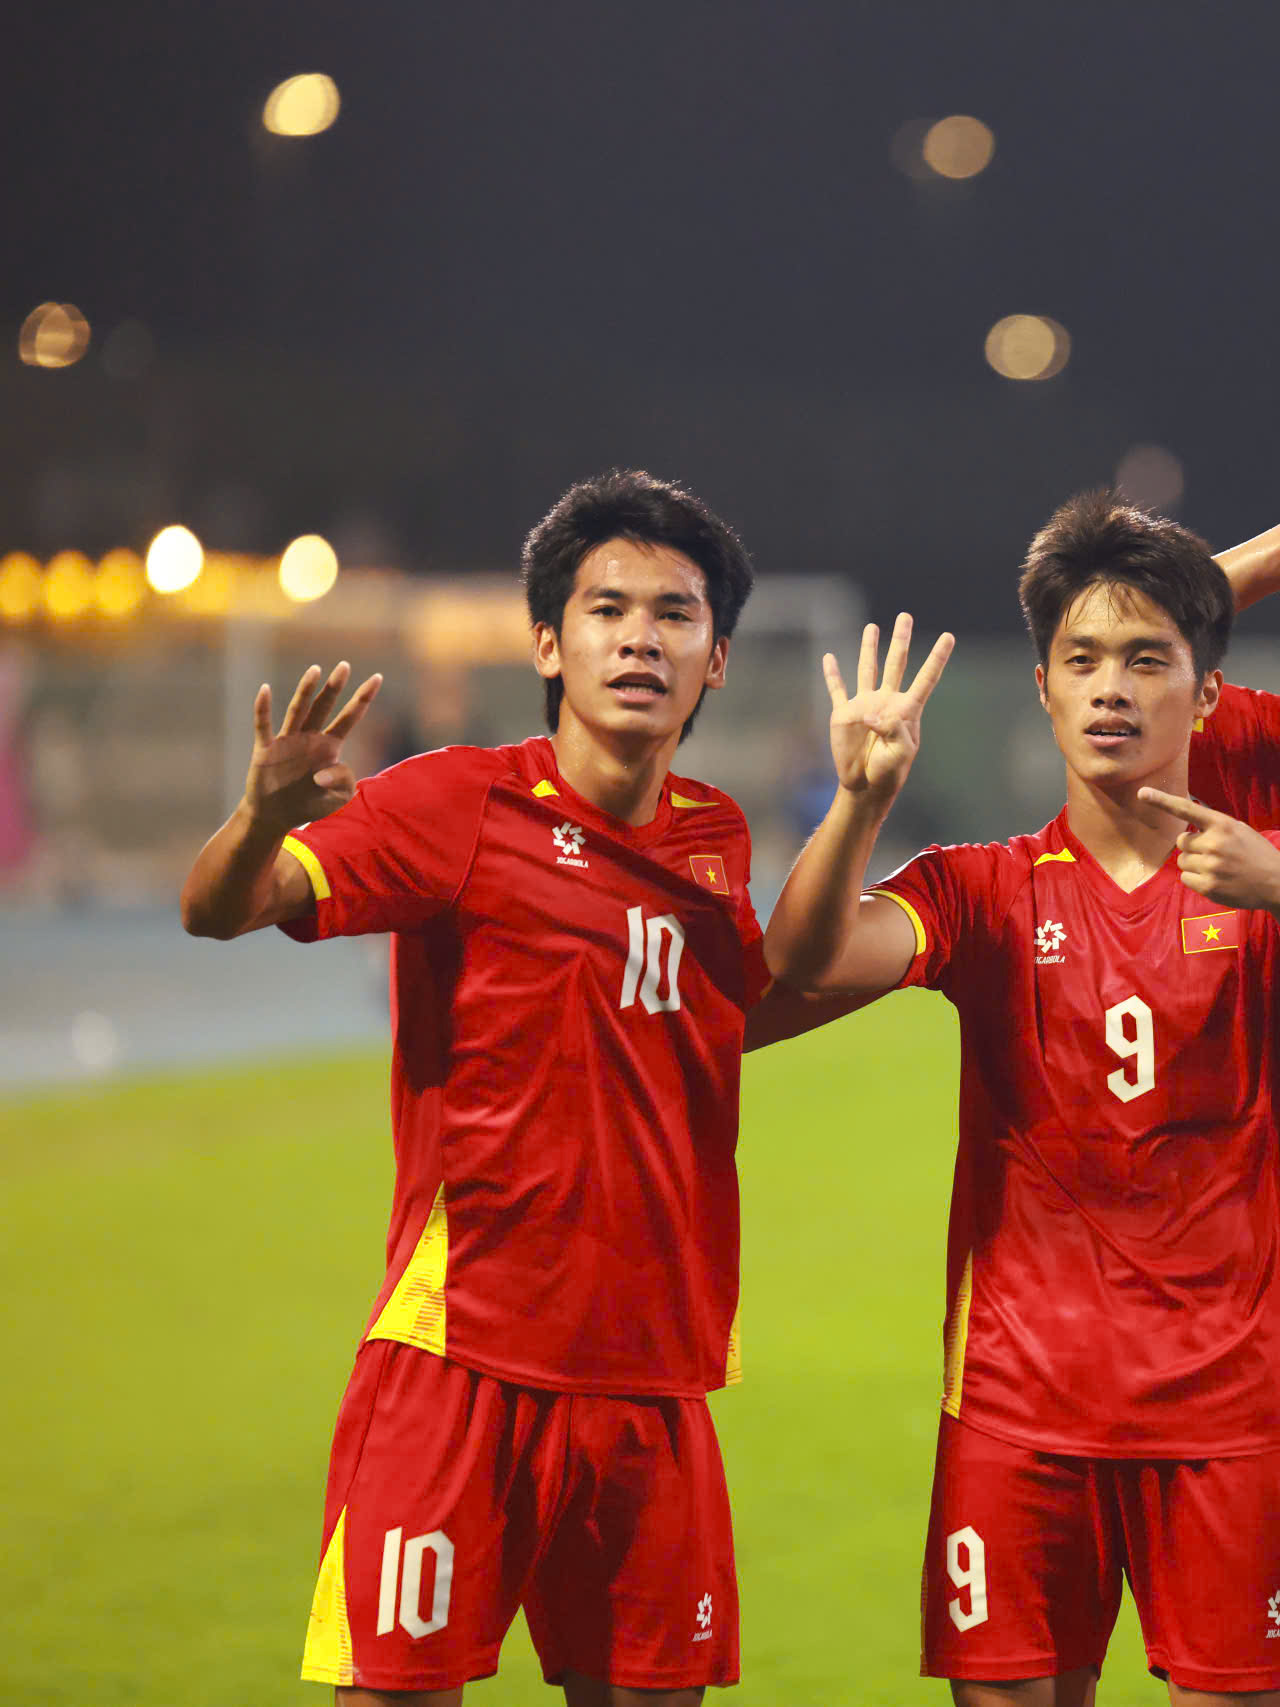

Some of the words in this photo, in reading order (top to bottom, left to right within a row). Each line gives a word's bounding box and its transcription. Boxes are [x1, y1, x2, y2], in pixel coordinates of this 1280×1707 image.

[619, 905, 685, 1015] 10
[1104, 994, 1156, 1104] 9
[376, 1525, 455, 1640] 10
[946, 1525, 989, 1633] 9
